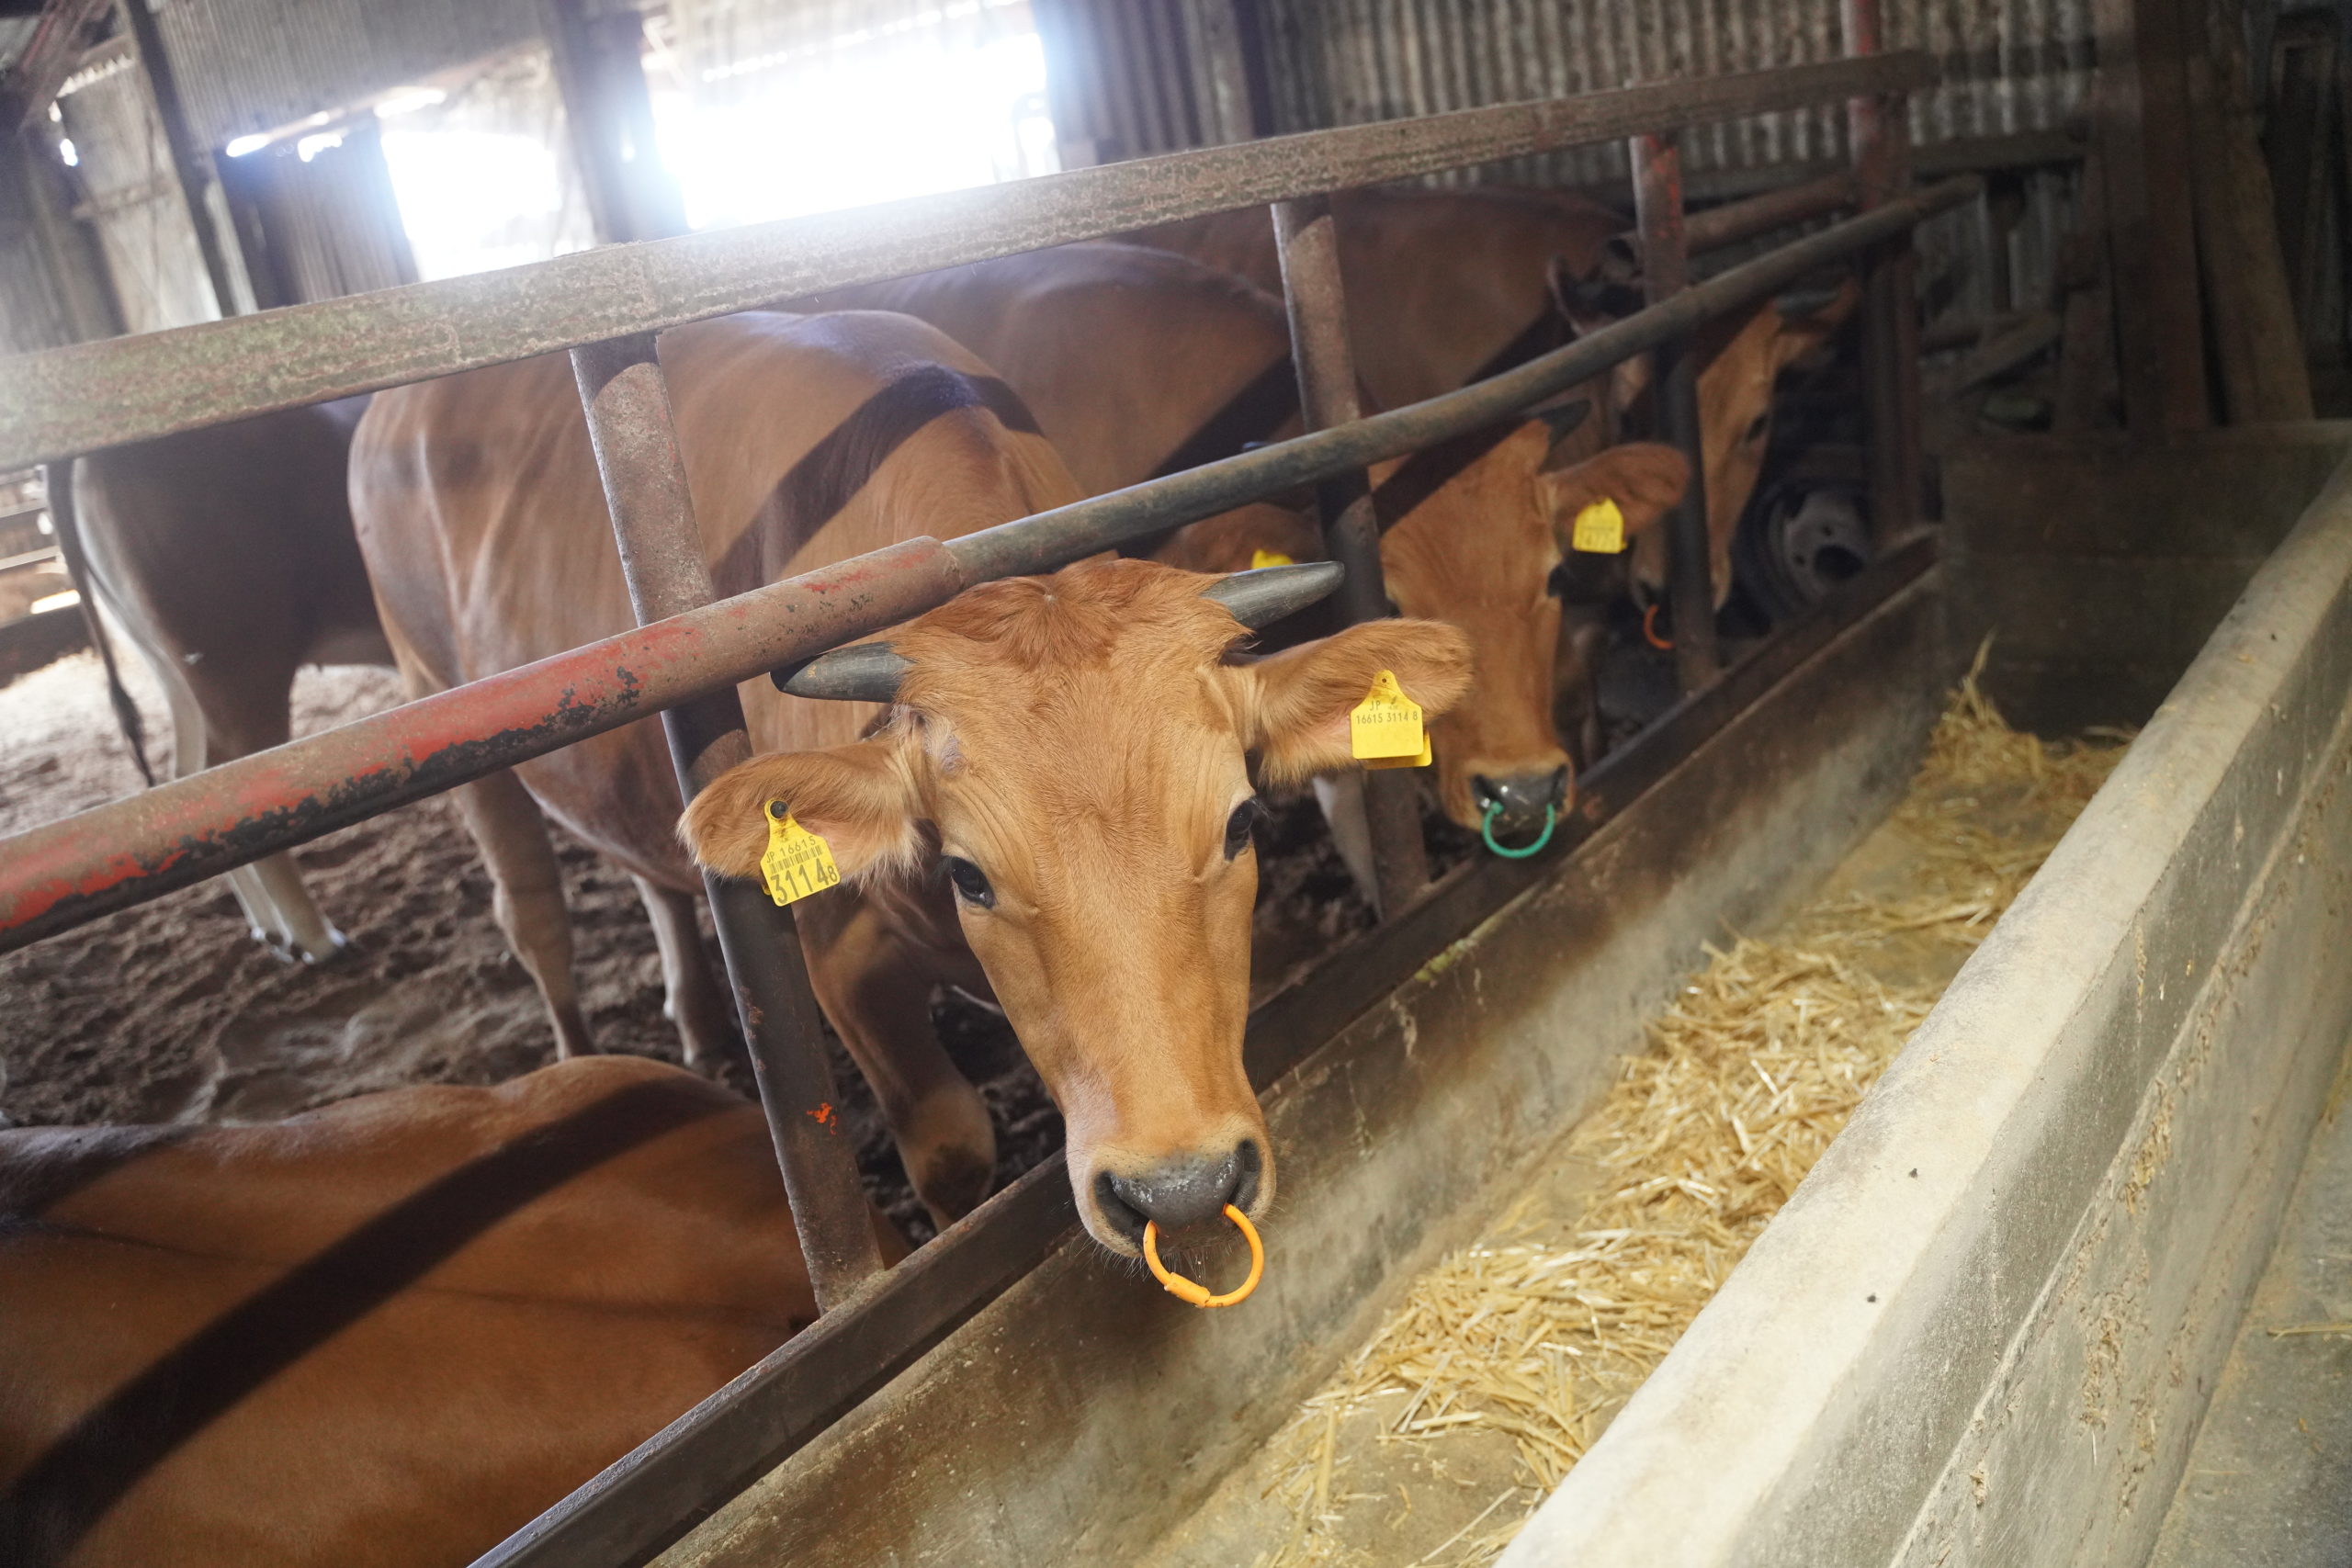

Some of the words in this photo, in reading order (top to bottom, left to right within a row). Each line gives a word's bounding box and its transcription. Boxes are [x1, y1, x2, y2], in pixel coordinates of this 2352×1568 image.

[1369, 700, 1381, 712] JP
[1356, 713, 1383, 725] 16615
[1386, 712, 1408, 723] 3114
[1412, 711, 1419, 721] 8
[766, 851, 775, 863] JP
[779, 836, 817, 857] 16615
